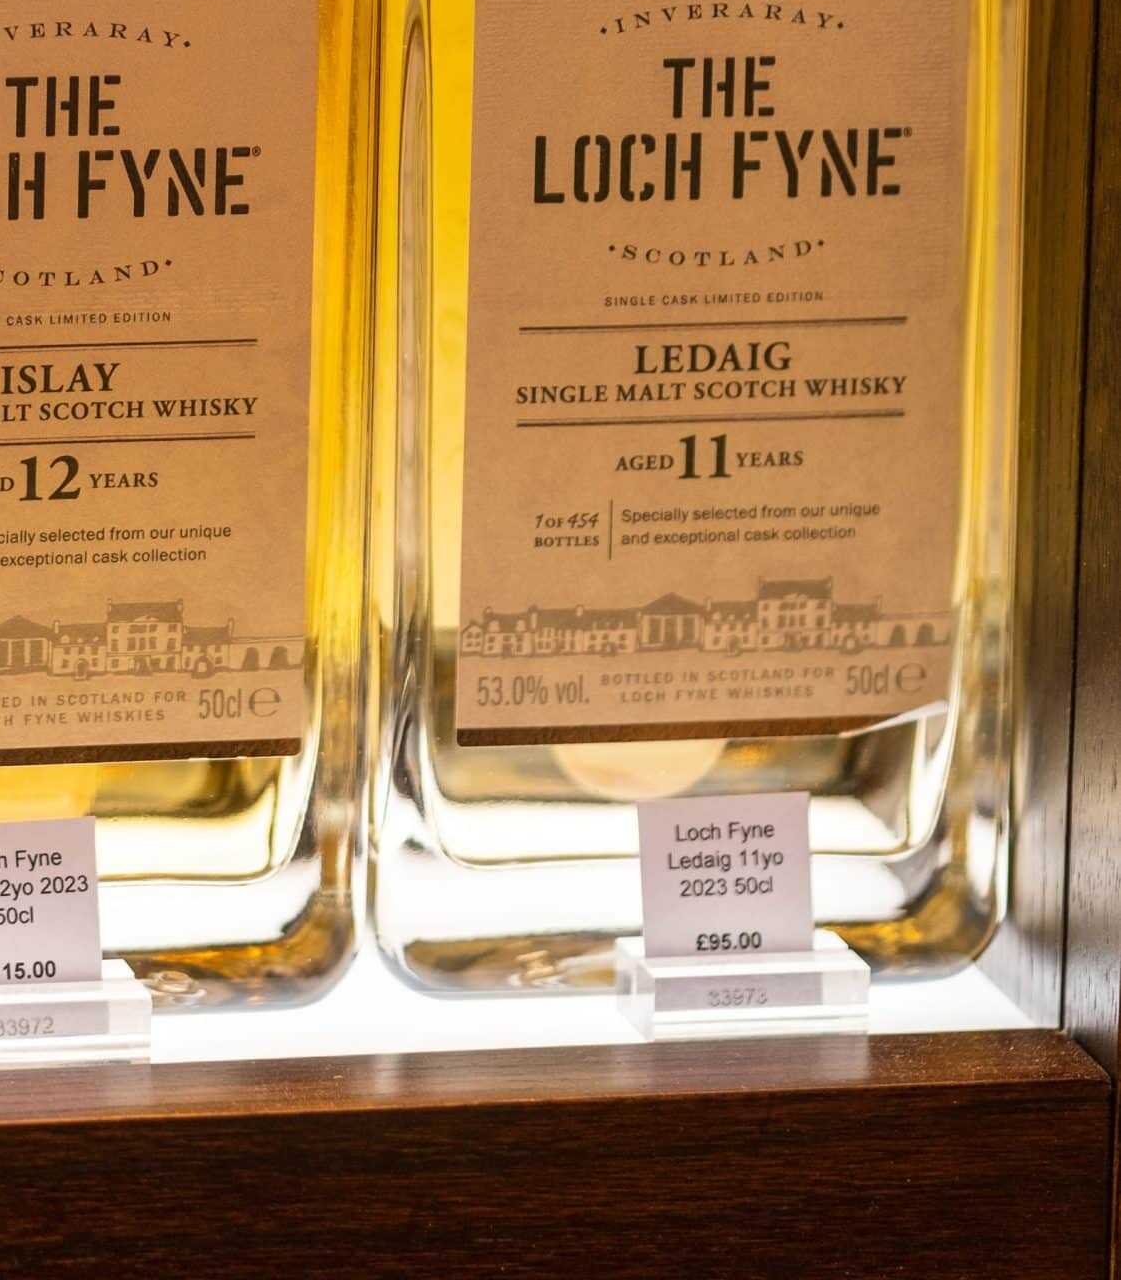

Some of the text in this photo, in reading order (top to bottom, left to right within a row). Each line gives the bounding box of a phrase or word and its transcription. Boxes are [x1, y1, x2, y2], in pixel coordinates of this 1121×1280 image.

[614, 2, 834, 34] INVERARAY
[662, 55, 776, 120] THE
[5, 74, 122, 138] THE
[533, 132, 702, 205] LOCH
[621, 240, 812, 268] SCOTLAND
[604, 290, 824, 308] SINGLE CASK LIMITED EDITION
[6, 314, 43, 327] CASK
[49, 312, 108, 325] LIMITED
[113, 311, 171, 324] EDITION
[634, 341, 792, 375] LEDAIG
[0, 362, 121, 395] ISLAY
[516, 375, 907, 405] SINGLE MALT SCOTCH WHISKY
[38, 400, 144, 422] SCOTCH
[152, 397, 258, 418] WHISKY
[615, 433, 804, 480] AGED 11 YEARS
[19, 454, 81, 502] 12
[89, 471, 159, 489] YEARS
[621, 502, 881, 525] Specially selected from our unique
[39, 527, 105, 543] selected
[109, 526, 145, 541] from
[149, 527, 176, 540] our
[179, 524, 232, 541] unique
[534, 535, 600, 548] BOTTLES
[620, 526, 856, 546] and exceptional cask collection
[0, 550, 88, 569] exceptional
[91, 549, 129, 564] cask
[131, 547, 207, 563] collection
[30, 695, 48, 708] IN
[54, 691, 146, 707] SCOTLAND
[153, 689, 187, 704] FOR
[198, 687, 242, 720] 50cl
[23, 712, 68, 727] FYNE
[76, 708, 166, 724] WHISKIES
[675, 821, 775, 844] Loch Fyne
[14, 849, 63, 872] Fyne
[667, 849, 784, 873] Ledaig 11yo
[40, 874, 89, 895] 2023
[679, 875, 774, 898] 2023 50cl
[695, 931, 762, 952] £95.00
